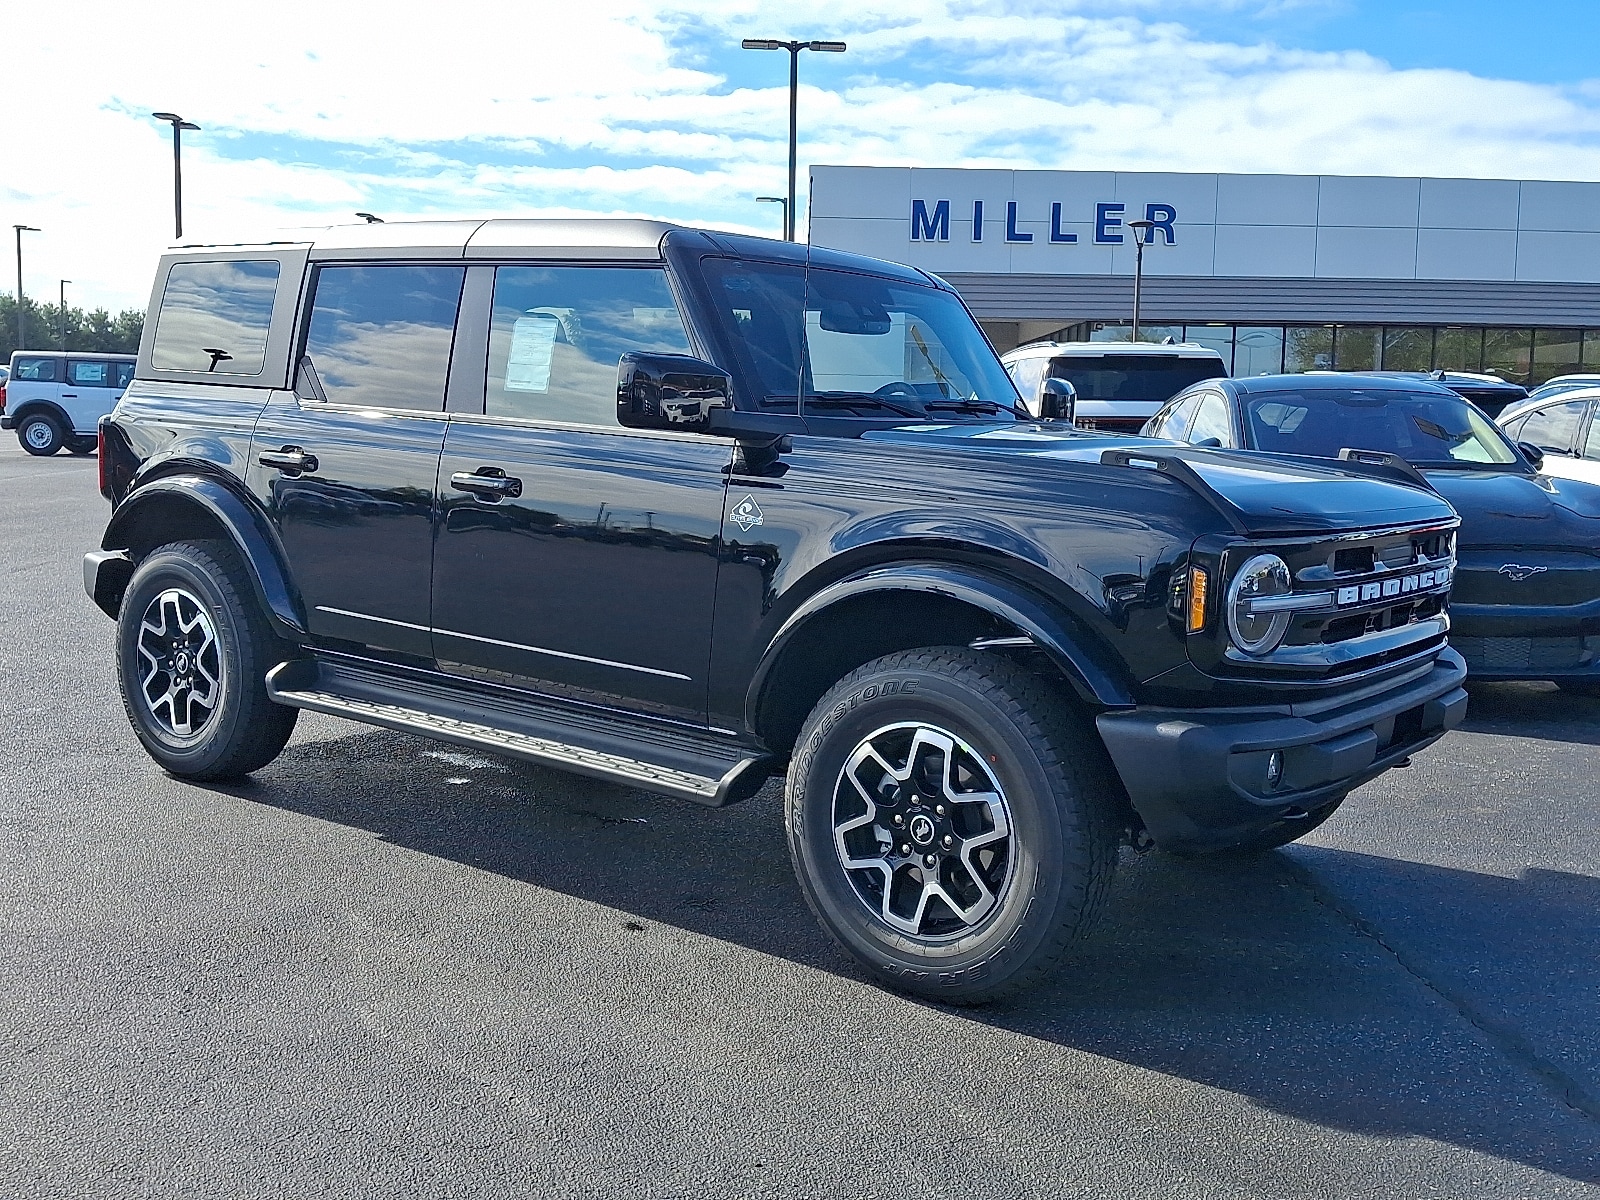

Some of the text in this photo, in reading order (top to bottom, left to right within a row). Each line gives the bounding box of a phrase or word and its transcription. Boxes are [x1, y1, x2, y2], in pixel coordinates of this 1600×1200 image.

[910, 199, 1177, 246] MILLER
[1338, 568, 1450, 605] BRONCO
[793, 678, 920, 838] BRIDGESTONE
